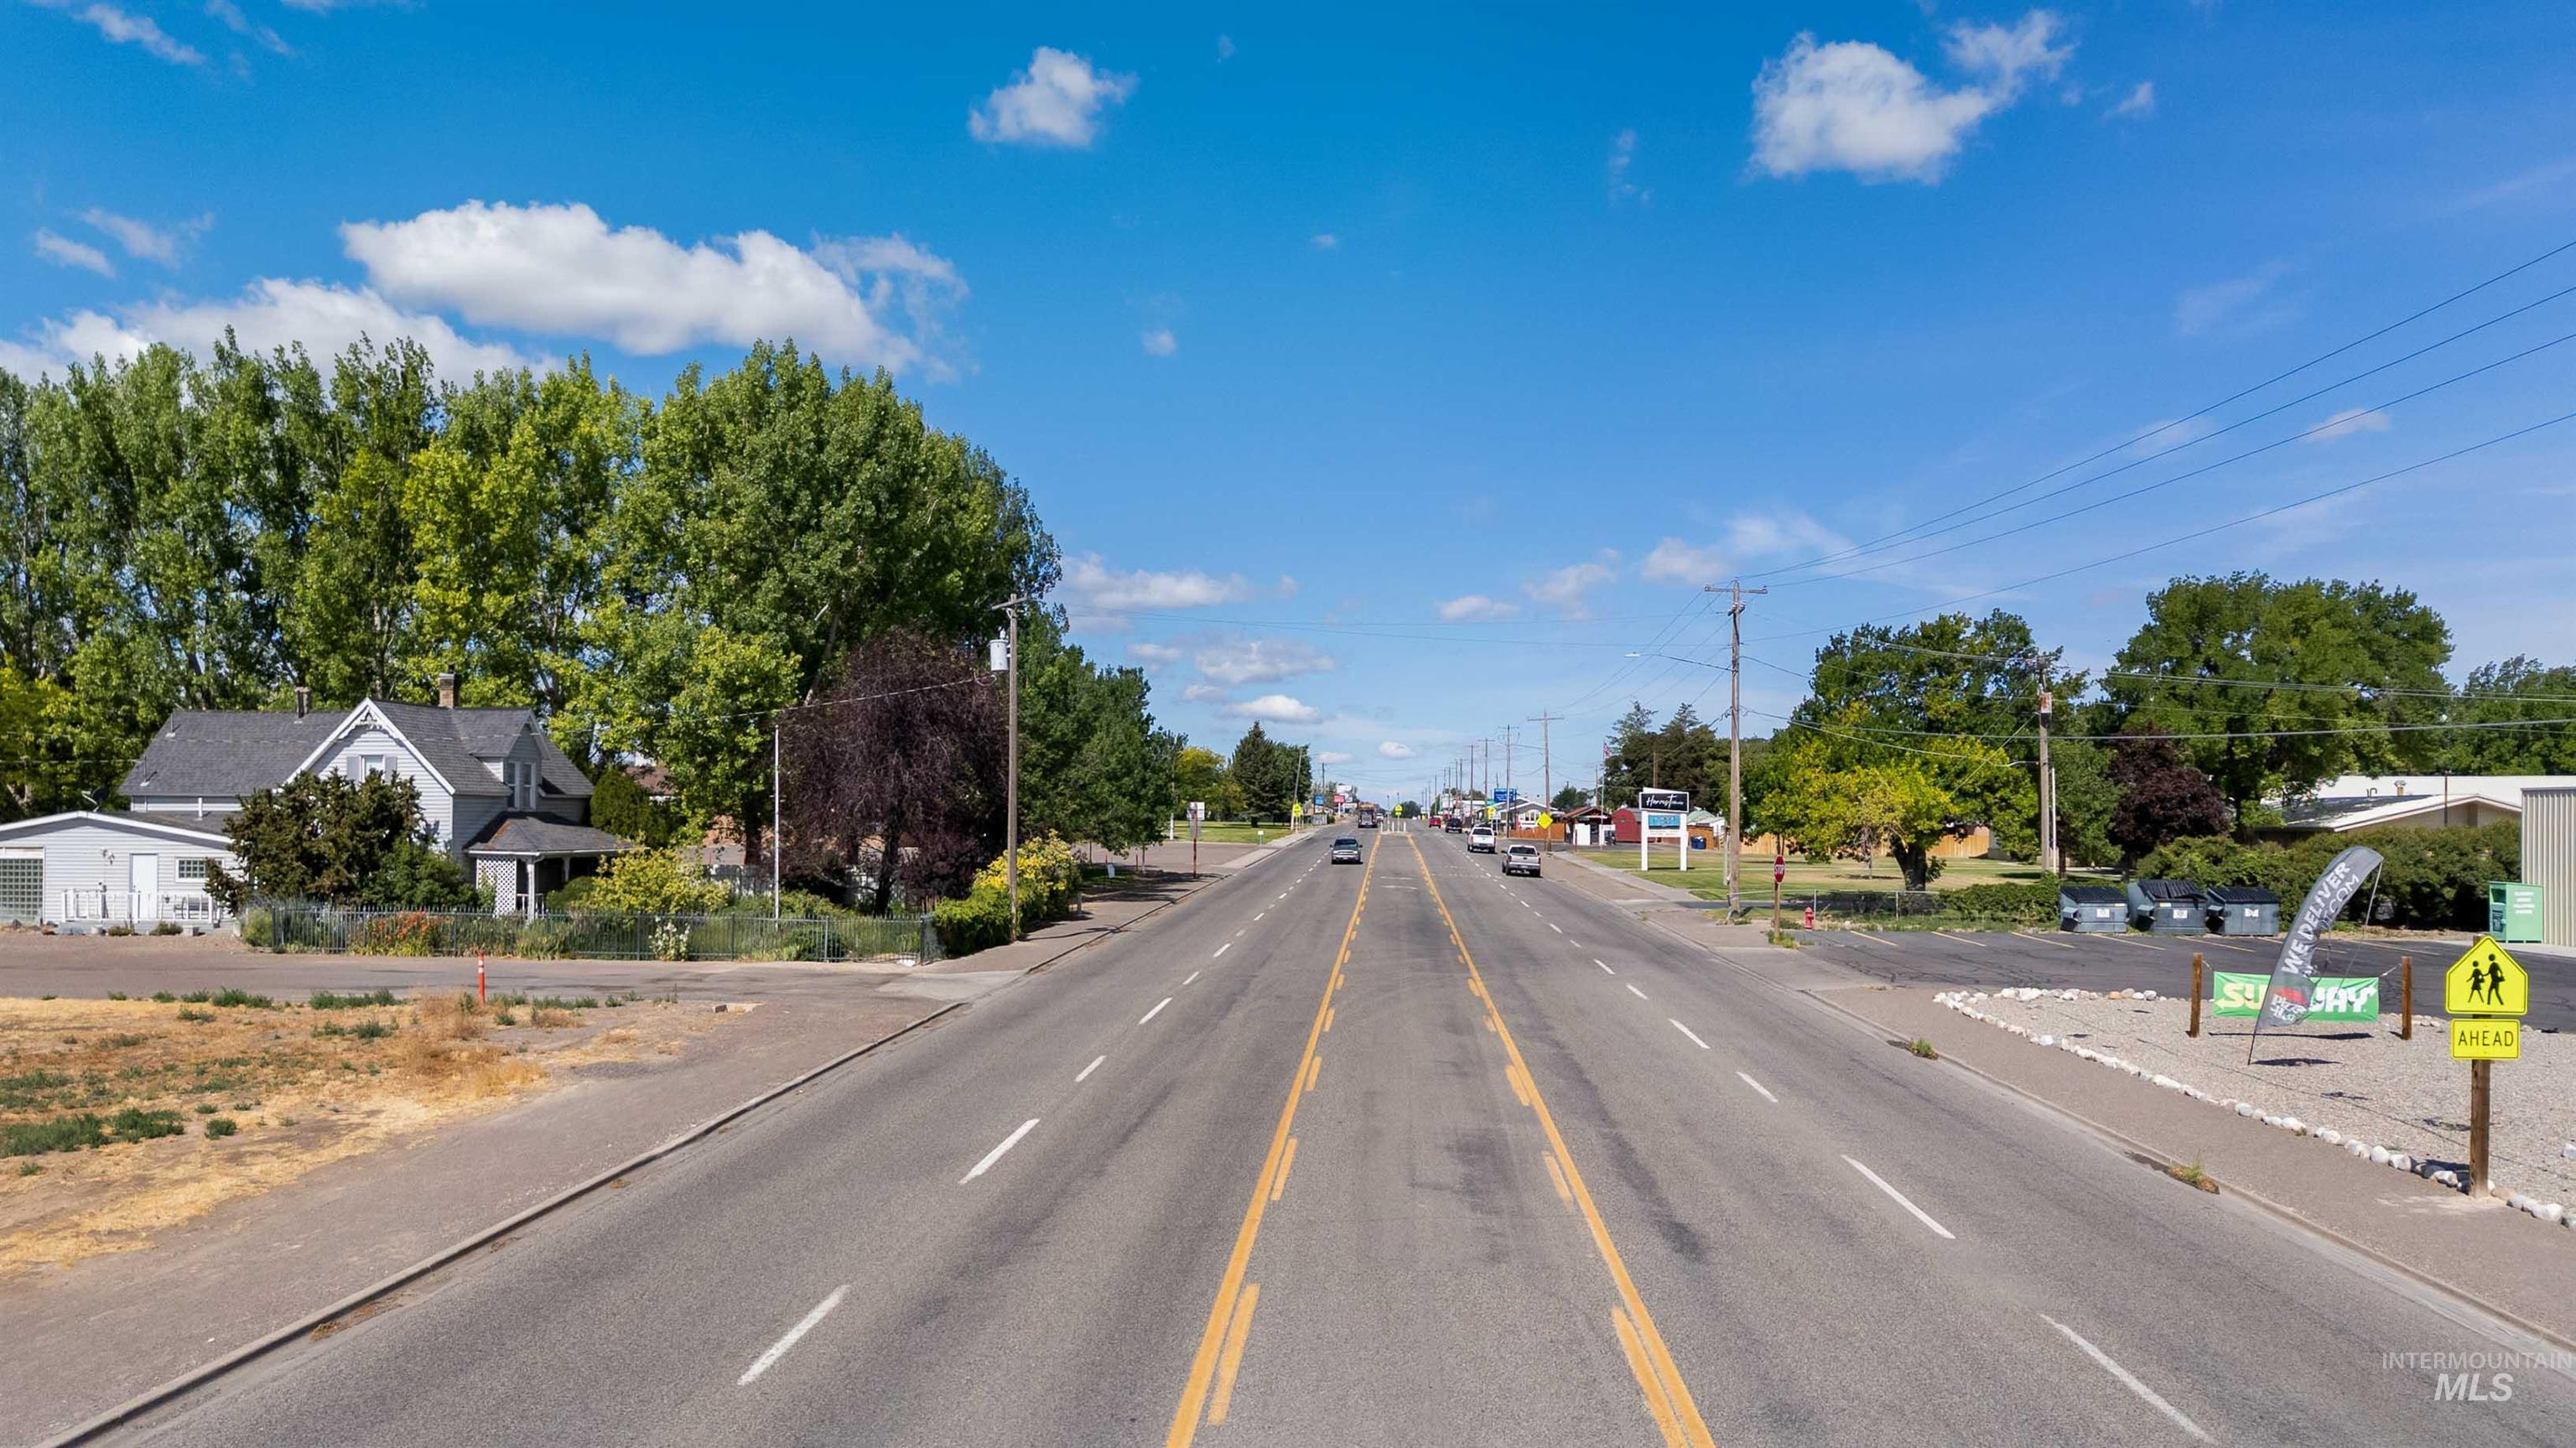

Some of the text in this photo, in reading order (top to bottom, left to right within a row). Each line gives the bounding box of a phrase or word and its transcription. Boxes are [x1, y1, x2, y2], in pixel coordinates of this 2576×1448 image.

[1774, 864, 1785, 875] STOP
[2282, 861, 2351, 974] WE DELIVER
[2458, 1030, 2514, 1046] AHEAD
